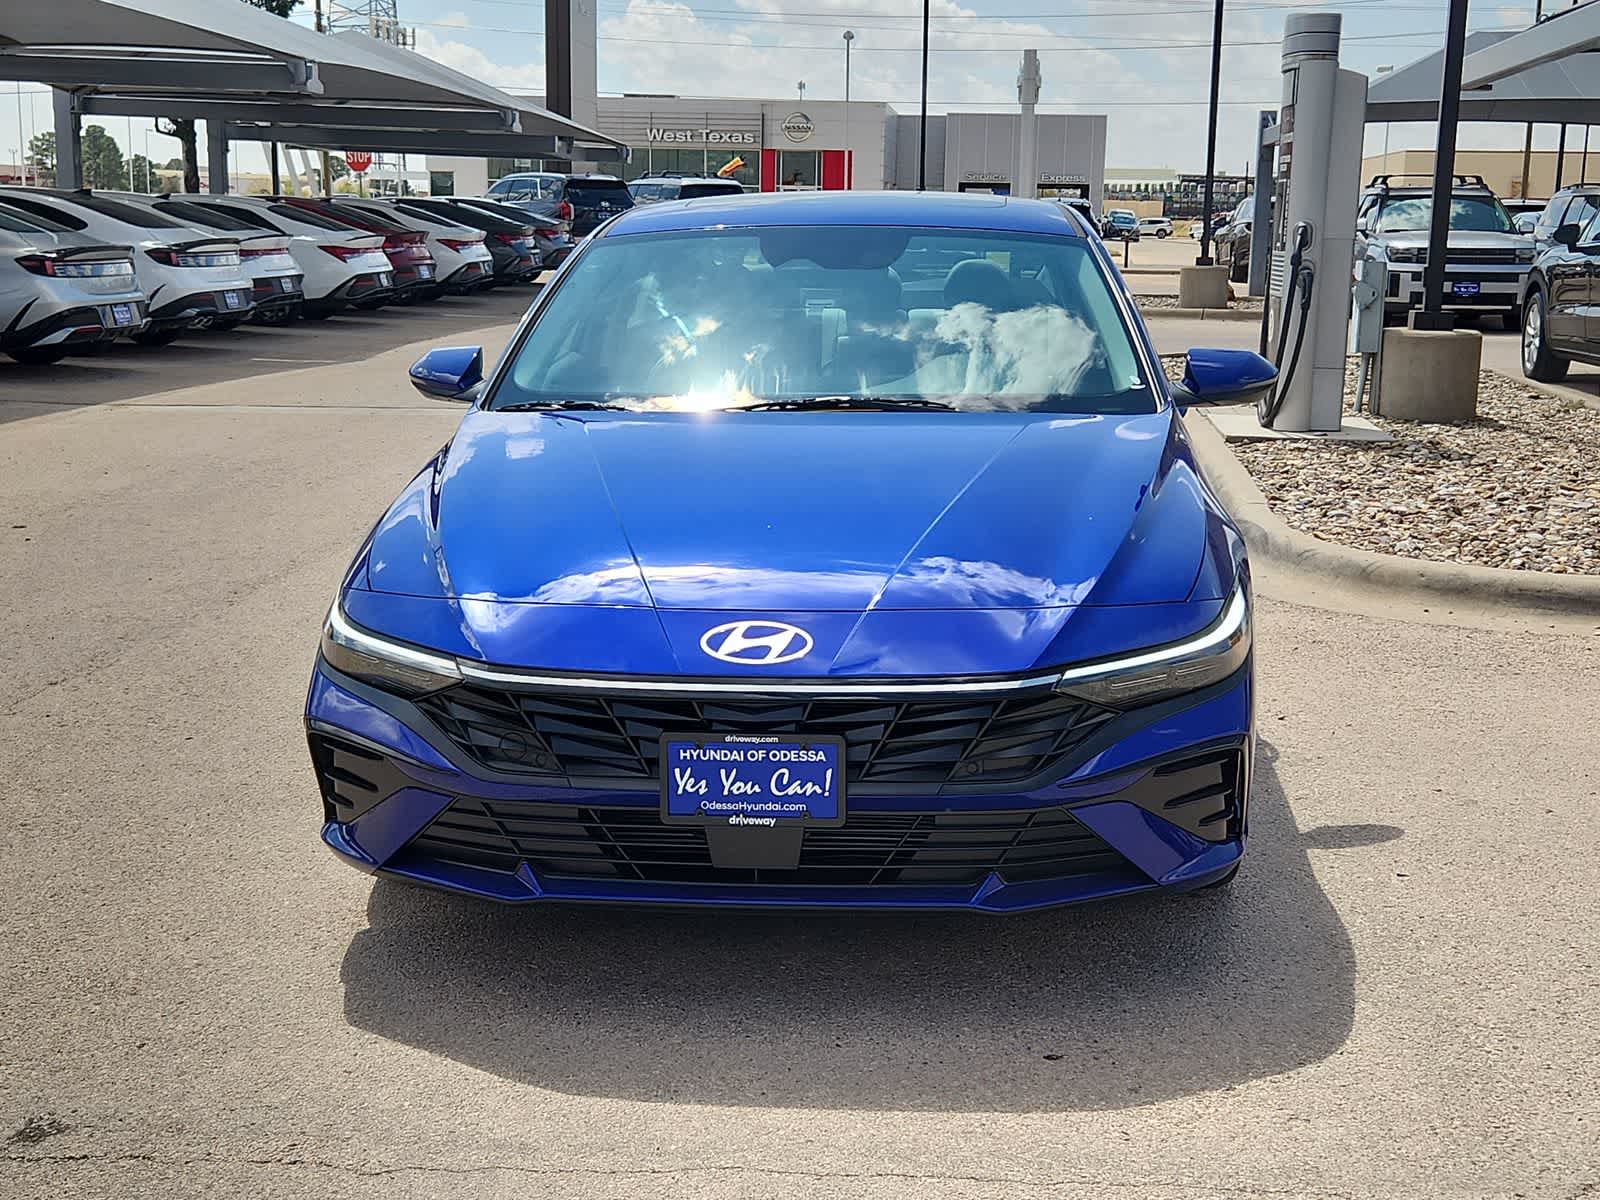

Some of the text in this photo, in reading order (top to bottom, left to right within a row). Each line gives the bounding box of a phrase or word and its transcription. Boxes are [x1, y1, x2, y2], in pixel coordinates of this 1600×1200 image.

[646, 128, 755, 143] West Texas
[347, 151, 370, 163] STOP
[966, 173, 1008, 182] Service
[1041, 173, 1087, 184] Express
[725, 735, 779, 745] driveway.com
[679, 749, 827, 762] HYUNDAI OF ODESSA
[674, 767, 833, 797] Yes You Can!
[700, 801, 807, 812] OdessaHyundai.com
[728, 814, 777, 828] driveway
